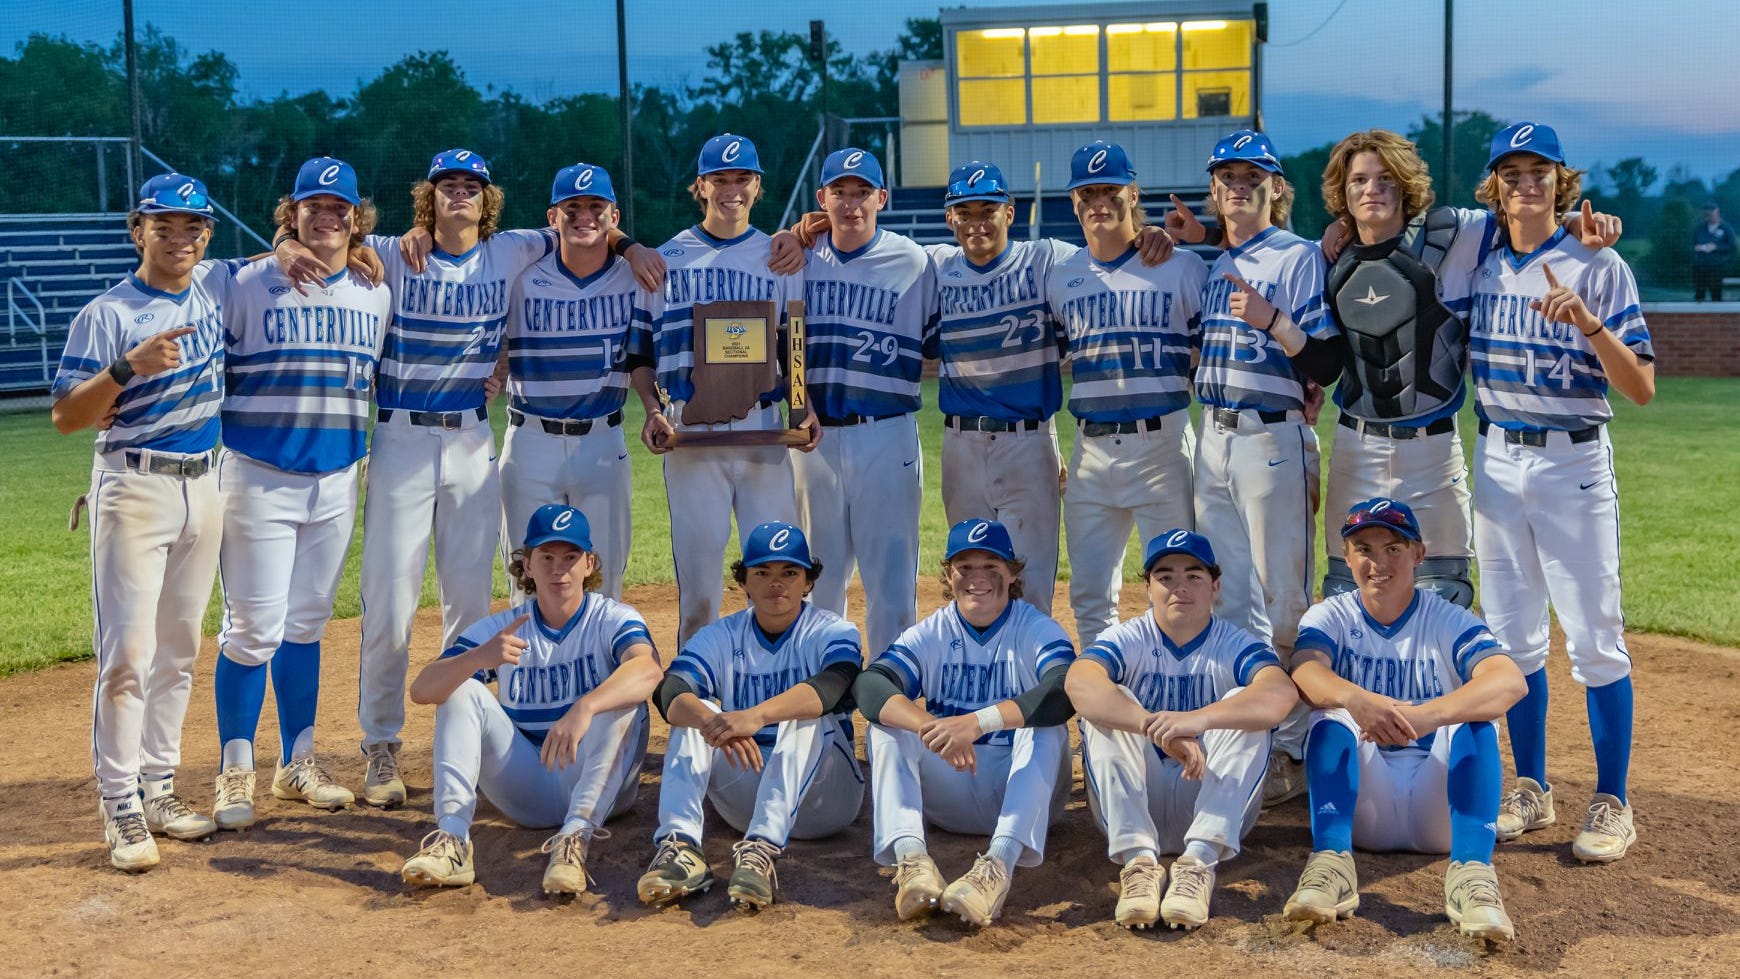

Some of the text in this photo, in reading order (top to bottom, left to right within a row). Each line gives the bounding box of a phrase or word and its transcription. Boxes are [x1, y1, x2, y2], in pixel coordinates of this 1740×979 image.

[1511, 125, 1533, 148] C
[721, 141, 740, 163] C
[844, 152, 863, 169] C
[1087, 150, 1107, 173] C
[318, 165, 340, 185] C
[574, 169, 593, 190] C
[805, 280, 899, 325] NTERVILLE
[1000, 310, 1045, 348] 23
[852, 331, 899, 366] 29
[1130, 337, 1162, 369] 11
[1229, 326, 1267, 363] 13
[1523, 349, 1574, 389] 14
[552, 510, 572, 530] C
[769, 529, 789, 550] C
[968, 522, 988, 542] C
[1166, 530, 1188, 547] C
